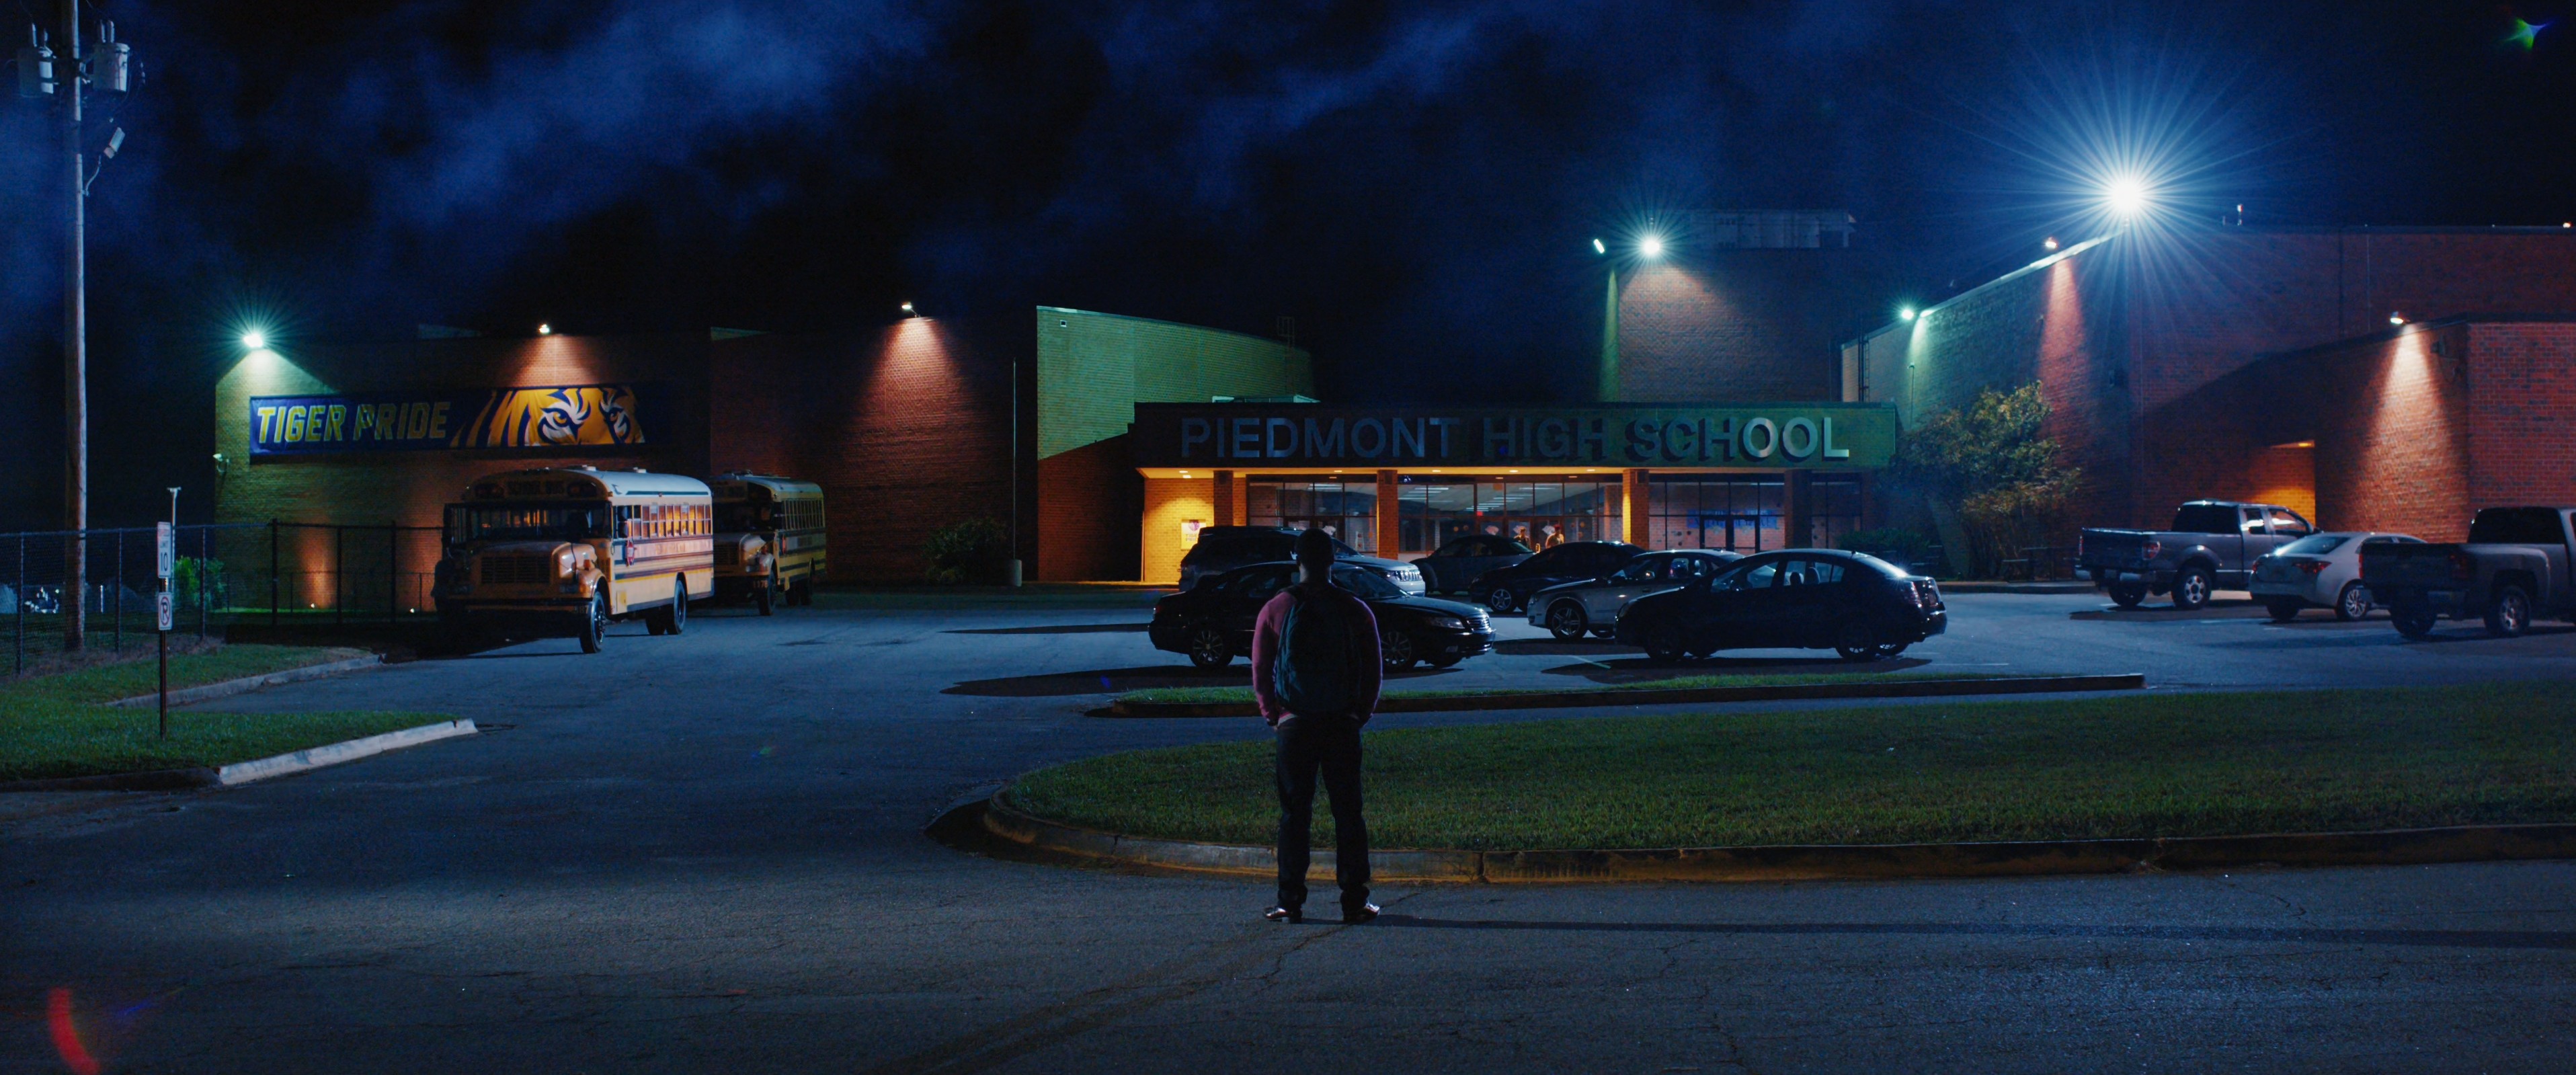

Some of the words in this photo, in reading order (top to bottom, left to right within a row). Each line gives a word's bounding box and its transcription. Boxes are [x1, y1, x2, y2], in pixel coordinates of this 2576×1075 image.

[257, 404, 348, 444] TIGER
[352, 401, 452, 441] PRIDE
[1181, 417, 1460, 459] PIEDMONT
[1483, 417, 1611, 459] HIGH
[1628, 416, 1849, 459] SCHOOL
[160, 552, 168, 571] 10
